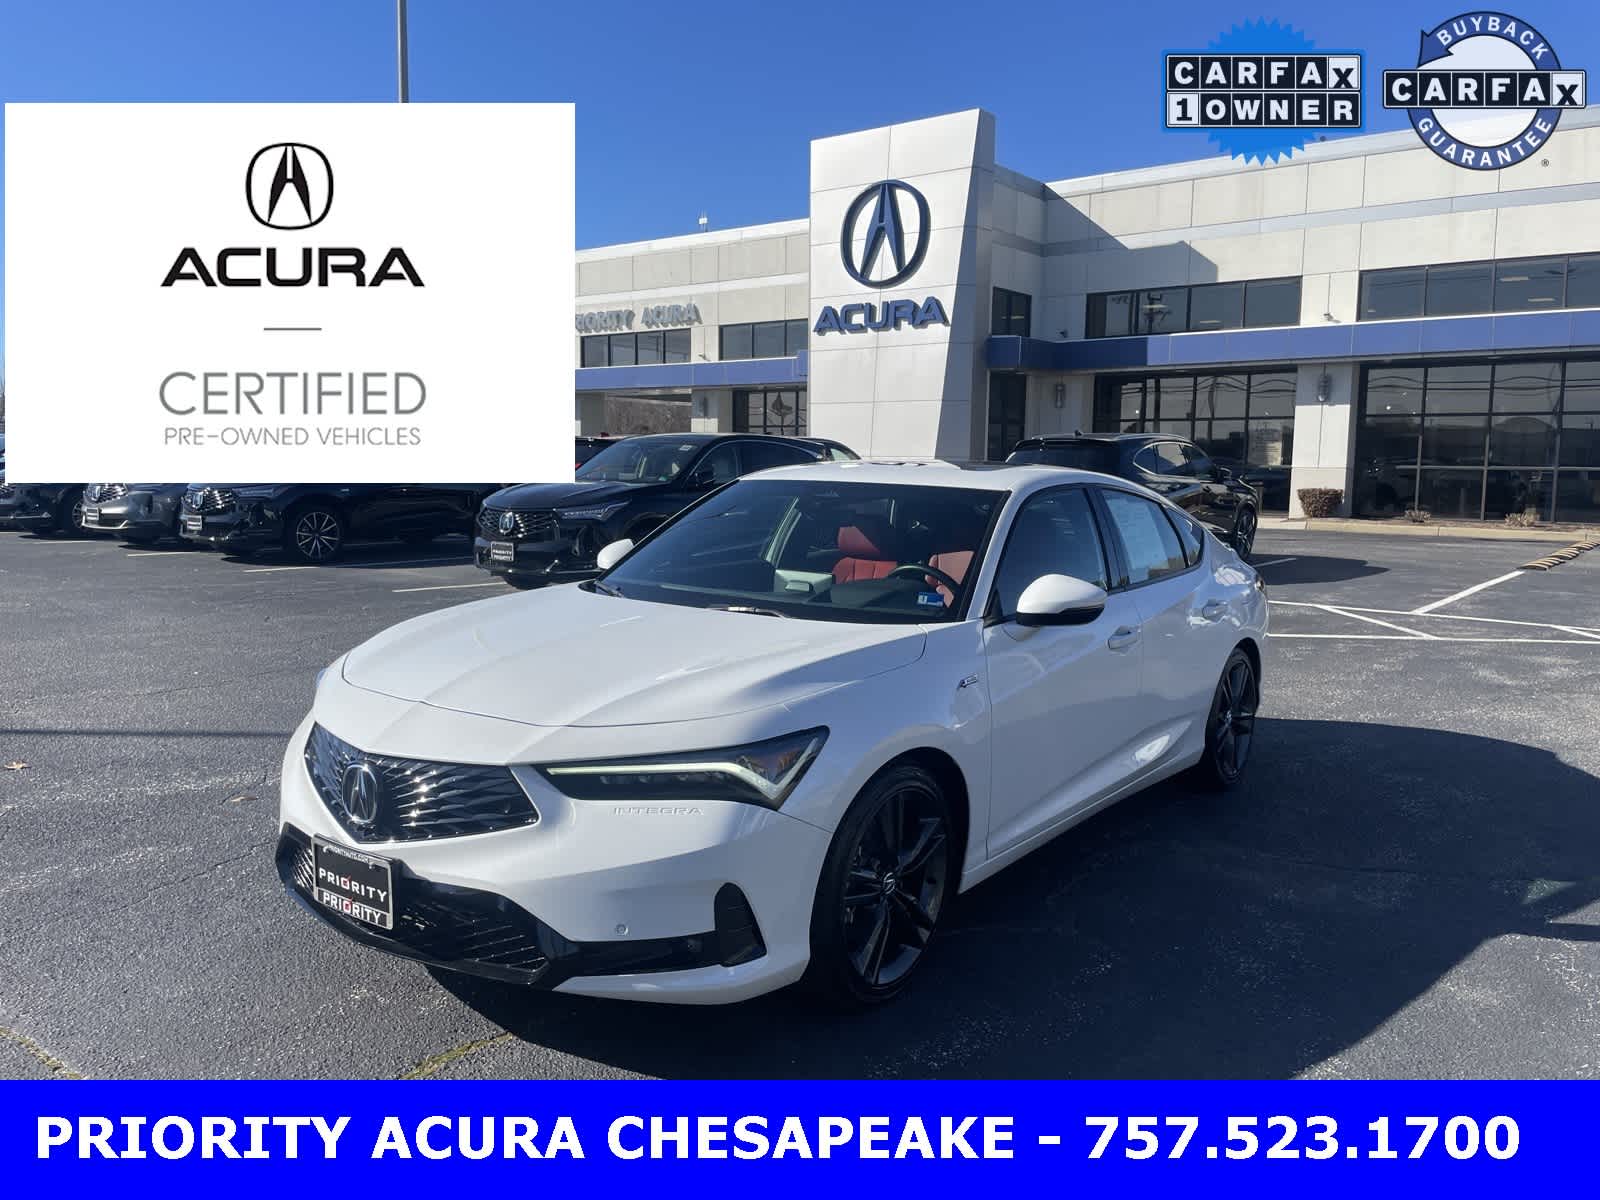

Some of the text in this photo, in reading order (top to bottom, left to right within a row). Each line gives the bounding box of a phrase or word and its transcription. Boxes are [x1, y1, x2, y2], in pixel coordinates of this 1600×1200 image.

[640, 303, 703, 327] ACURA
[813, 296, 950, 335] ACURA
[614, 807, 704, 816] INTEGRA
[319, 867, 387, 902] PRIORITY
[323, 892, 381, 924] PRIORITY
